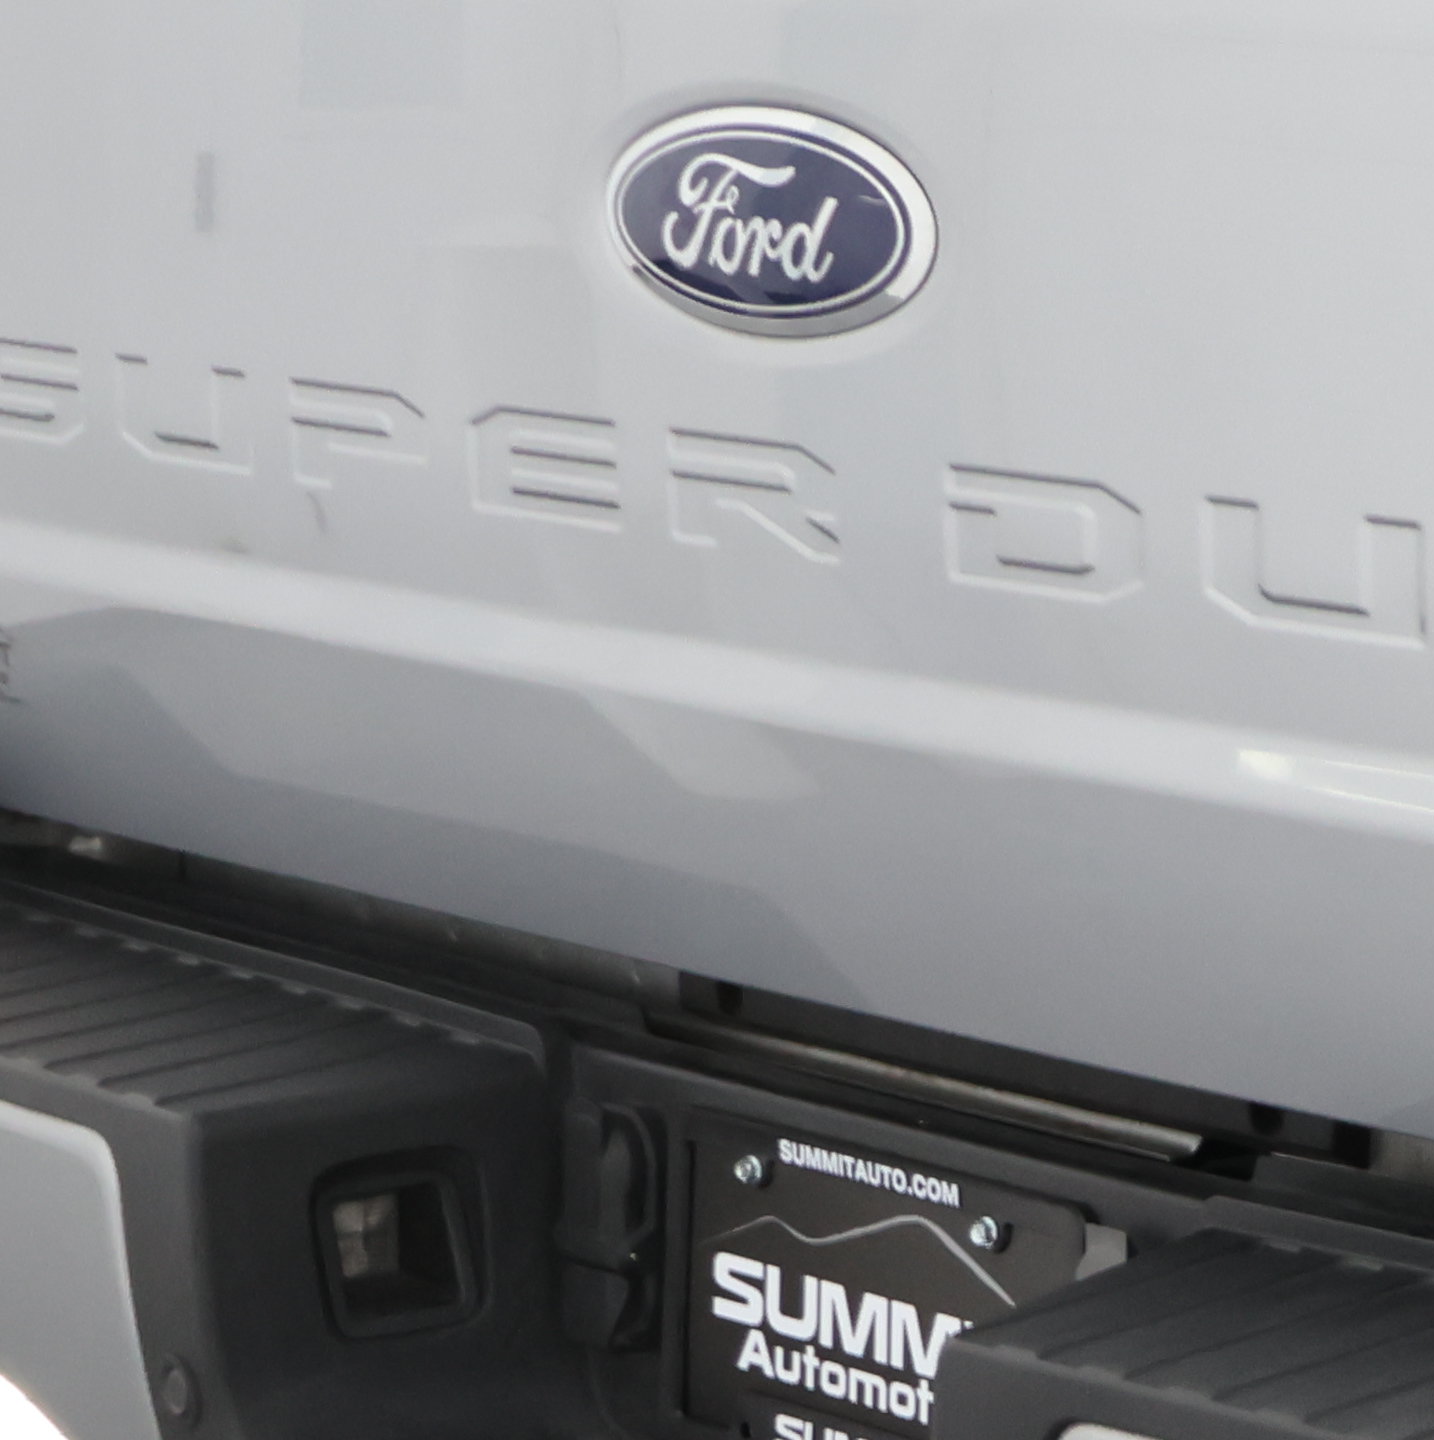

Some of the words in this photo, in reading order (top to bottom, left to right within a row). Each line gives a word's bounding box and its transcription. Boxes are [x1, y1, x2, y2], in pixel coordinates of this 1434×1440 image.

[661, 153, 838, 283] Ford
[0, 337, 840, 564] SUPER
[777, 1137, 961, 1208] SUMMITAUTO.COM
[712, 1251, 974, 1379] SUMM
